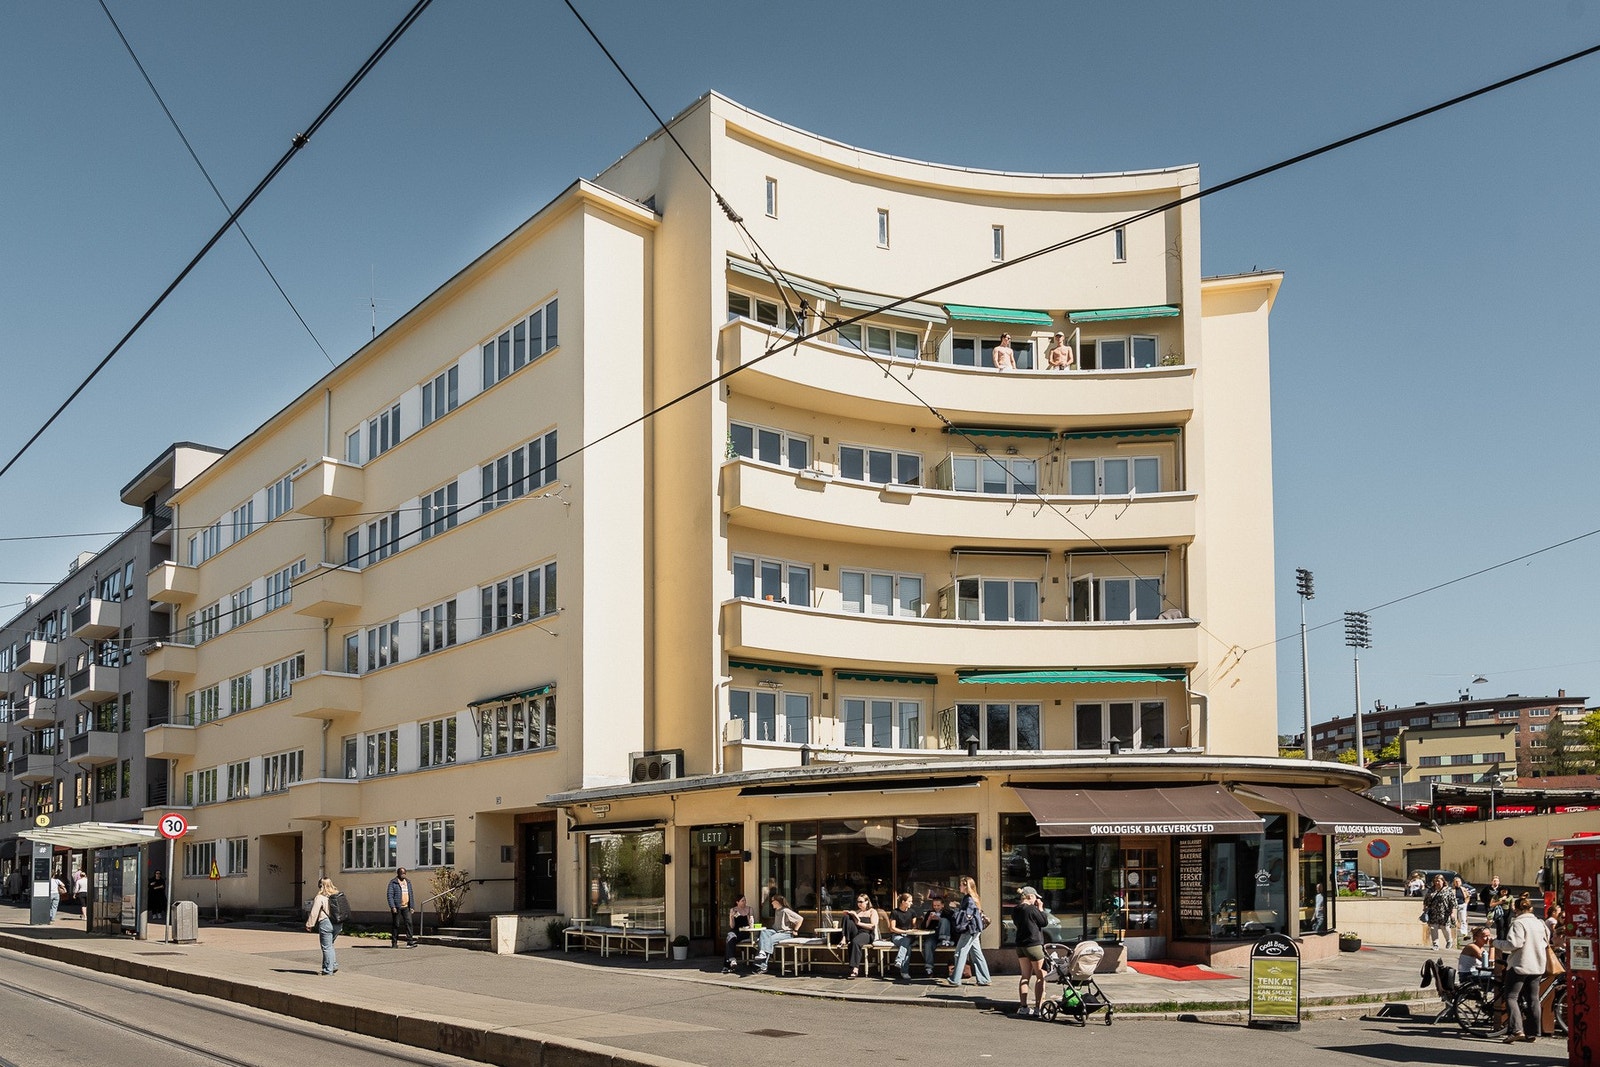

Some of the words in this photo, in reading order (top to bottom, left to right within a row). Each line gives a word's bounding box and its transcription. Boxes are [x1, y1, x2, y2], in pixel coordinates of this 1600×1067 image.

[165, 819, 182, 832] 30
[1090, 825, 1142, 834] ØKOLOGISK
[1144, 824, 1214, 834] BAKEVERKSTED
[1334, 825, 1364, 833] ØKOLOGISK
[1364, 826, 1403, 834] BAKEVERKSTED
[702, 832, 722, 843] LETT
[1180, 873, 1202, 881] FERSKT
[1257, 977, 1280, 985] TENK
[1281, 978, 1293, 986] AT
